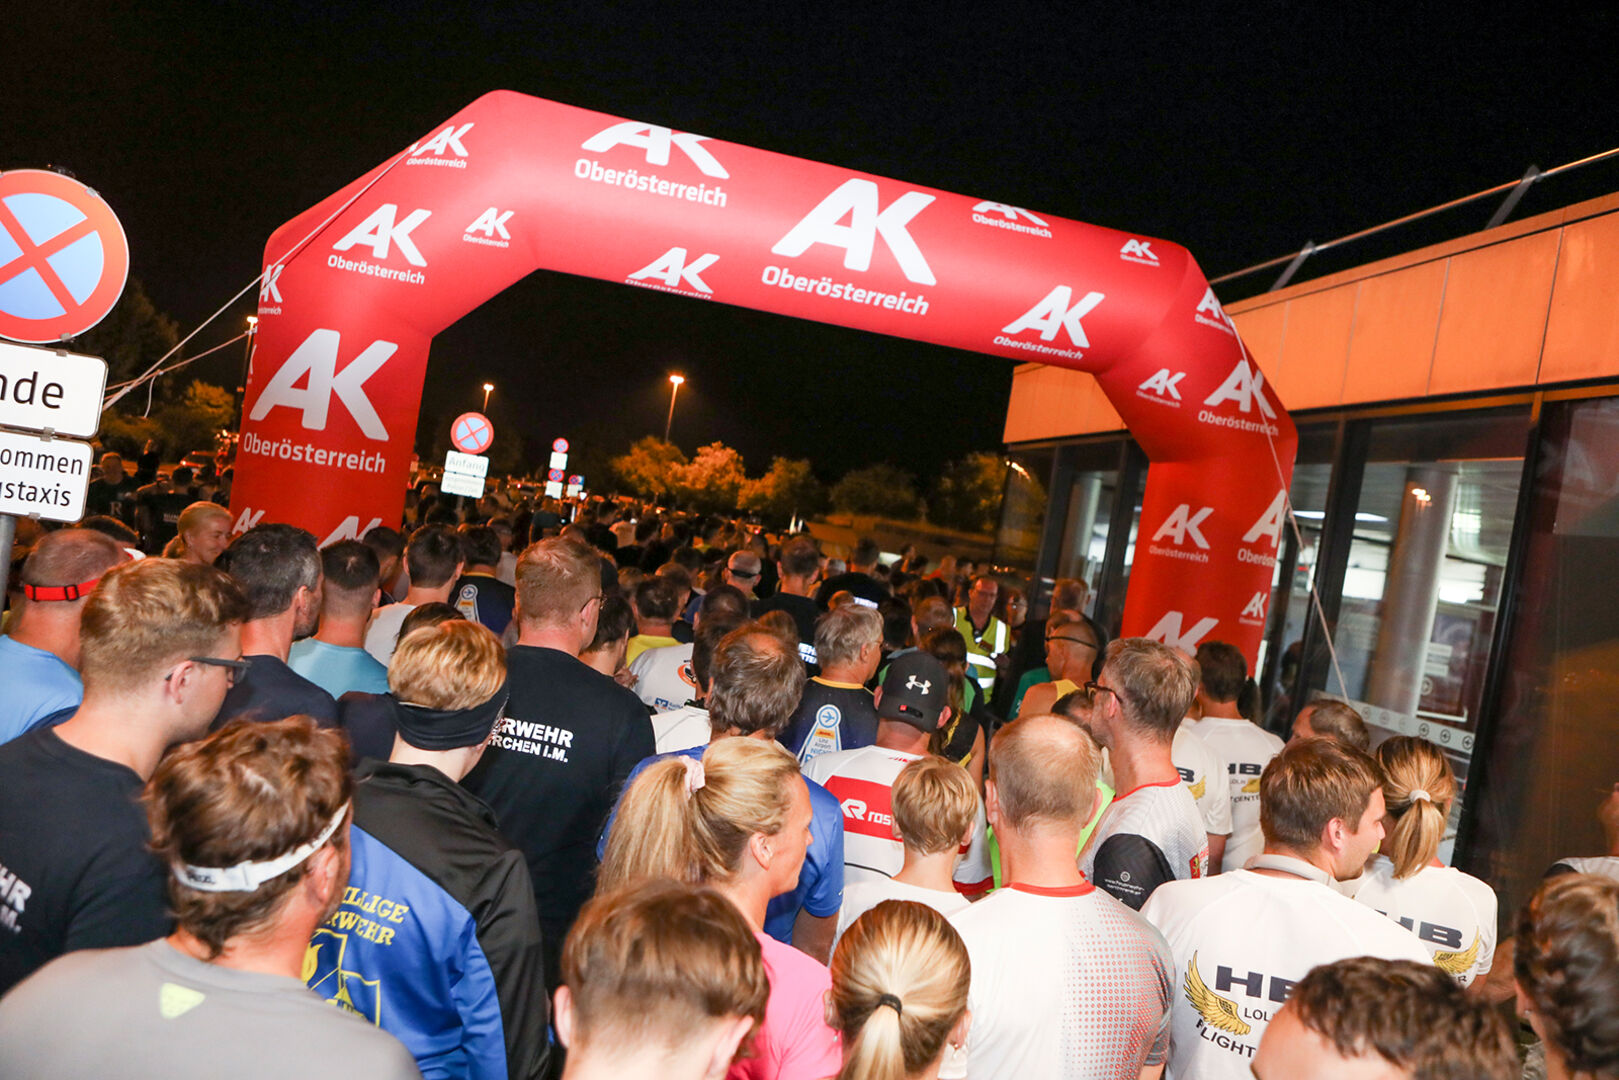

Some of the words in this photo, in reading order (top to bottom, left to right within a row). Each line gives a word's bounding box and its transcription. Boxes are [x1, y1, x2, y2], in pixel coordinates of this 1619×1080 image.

[411, 122, 475, 157] AK
[581, 121, 730, 179] AK
[406, 157, 467, 169] Oberösterreich
[574, 158, 728, 208] Oberösterreich
[464, 207, 514, 240] AK
[972, 200, 1050, 227] AK
[972, 213, 1053, 239] Oberösterreich
[332, 203, 432, 268] AK
[771, 178, 937, 286] AK
[1120, 239, 1159, 261] AK
[327, 254, 425, 284] Oberösterreich
[627, 246, 720, 293] AK
[761, 264, 929, 316] Oberösterreich
[1001, 284, 1105, 348] AK
[993, 335, 1084, 360] Oberösterreich
[249, 328, 398, 441] AK
[1138, 368, 1187, 400] AK
[1203, 359, 1278, 420] AK
[1198, 410, 1279, 436] Oberösterreich
[243, 431, 386, 474] Oberösterreich
[0, 480, 71, 507] staxis
[1151, 503, 1215, 550] AK
[1241, 591, 1268, 619] AK
[502, 718, 574, 748] RWEHR
